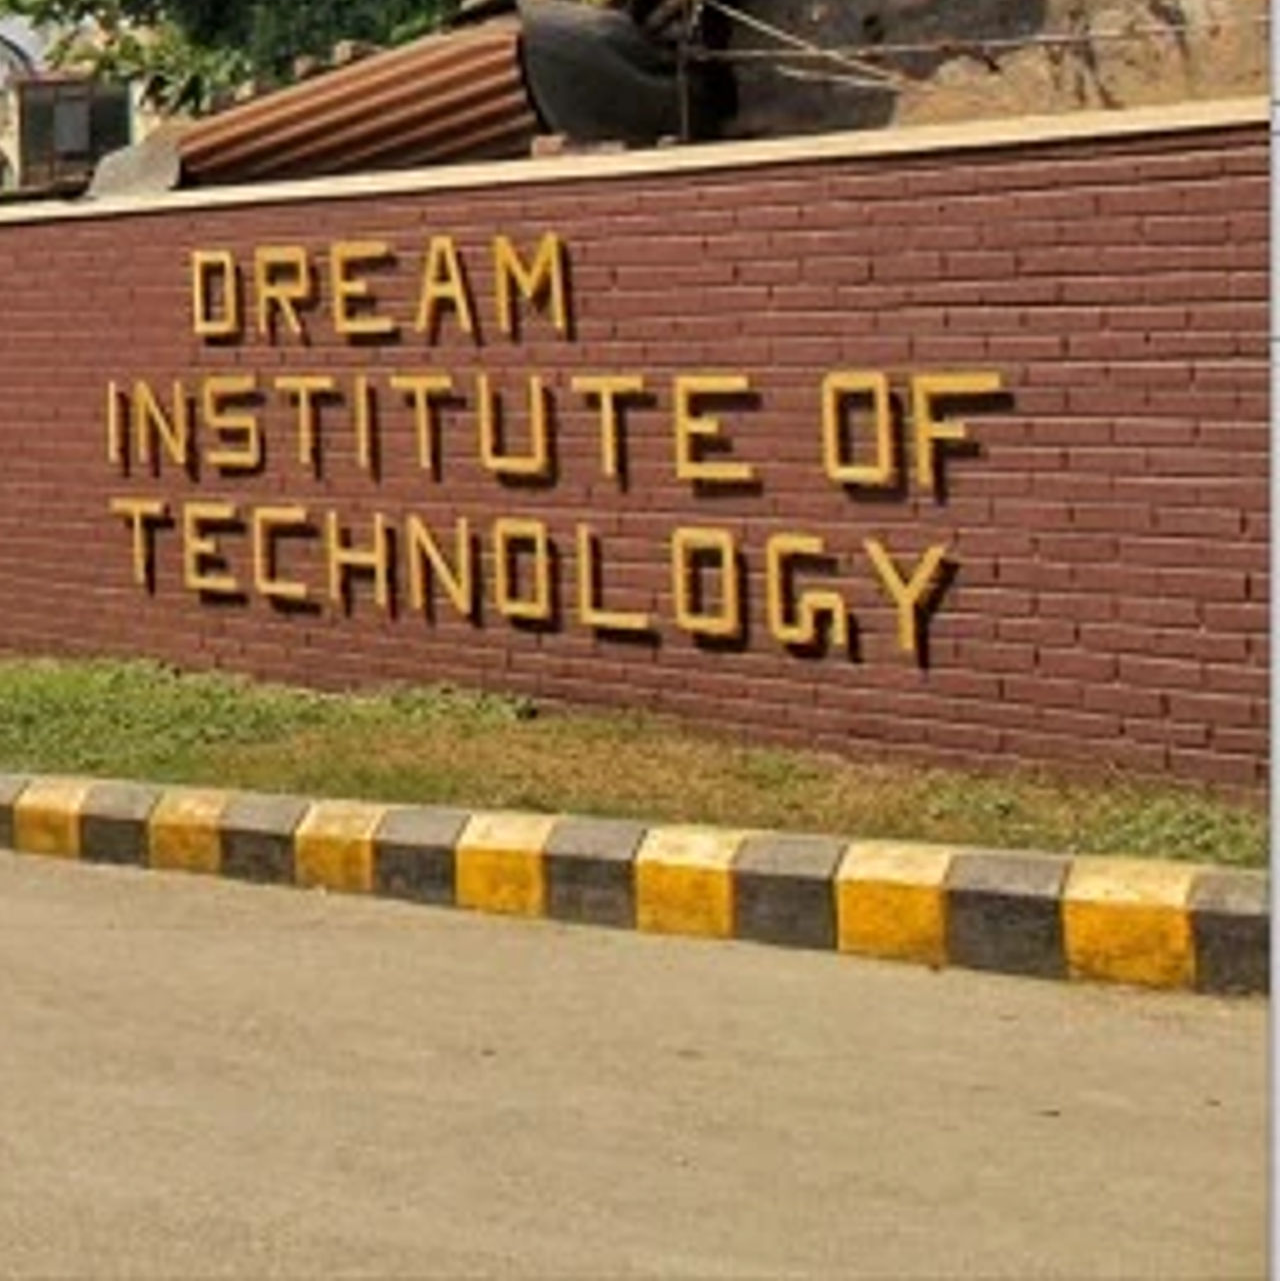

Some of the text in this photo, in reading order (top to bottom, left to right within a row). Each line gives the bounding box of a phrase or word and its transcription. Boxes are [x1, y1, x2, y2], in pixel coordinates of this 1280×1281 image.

[193, 233, 566, 336] DREAM
[107, 372, 1002, 488] INSTITUTE OF
[111, 498, 945, 652] TECHNOLOGY
